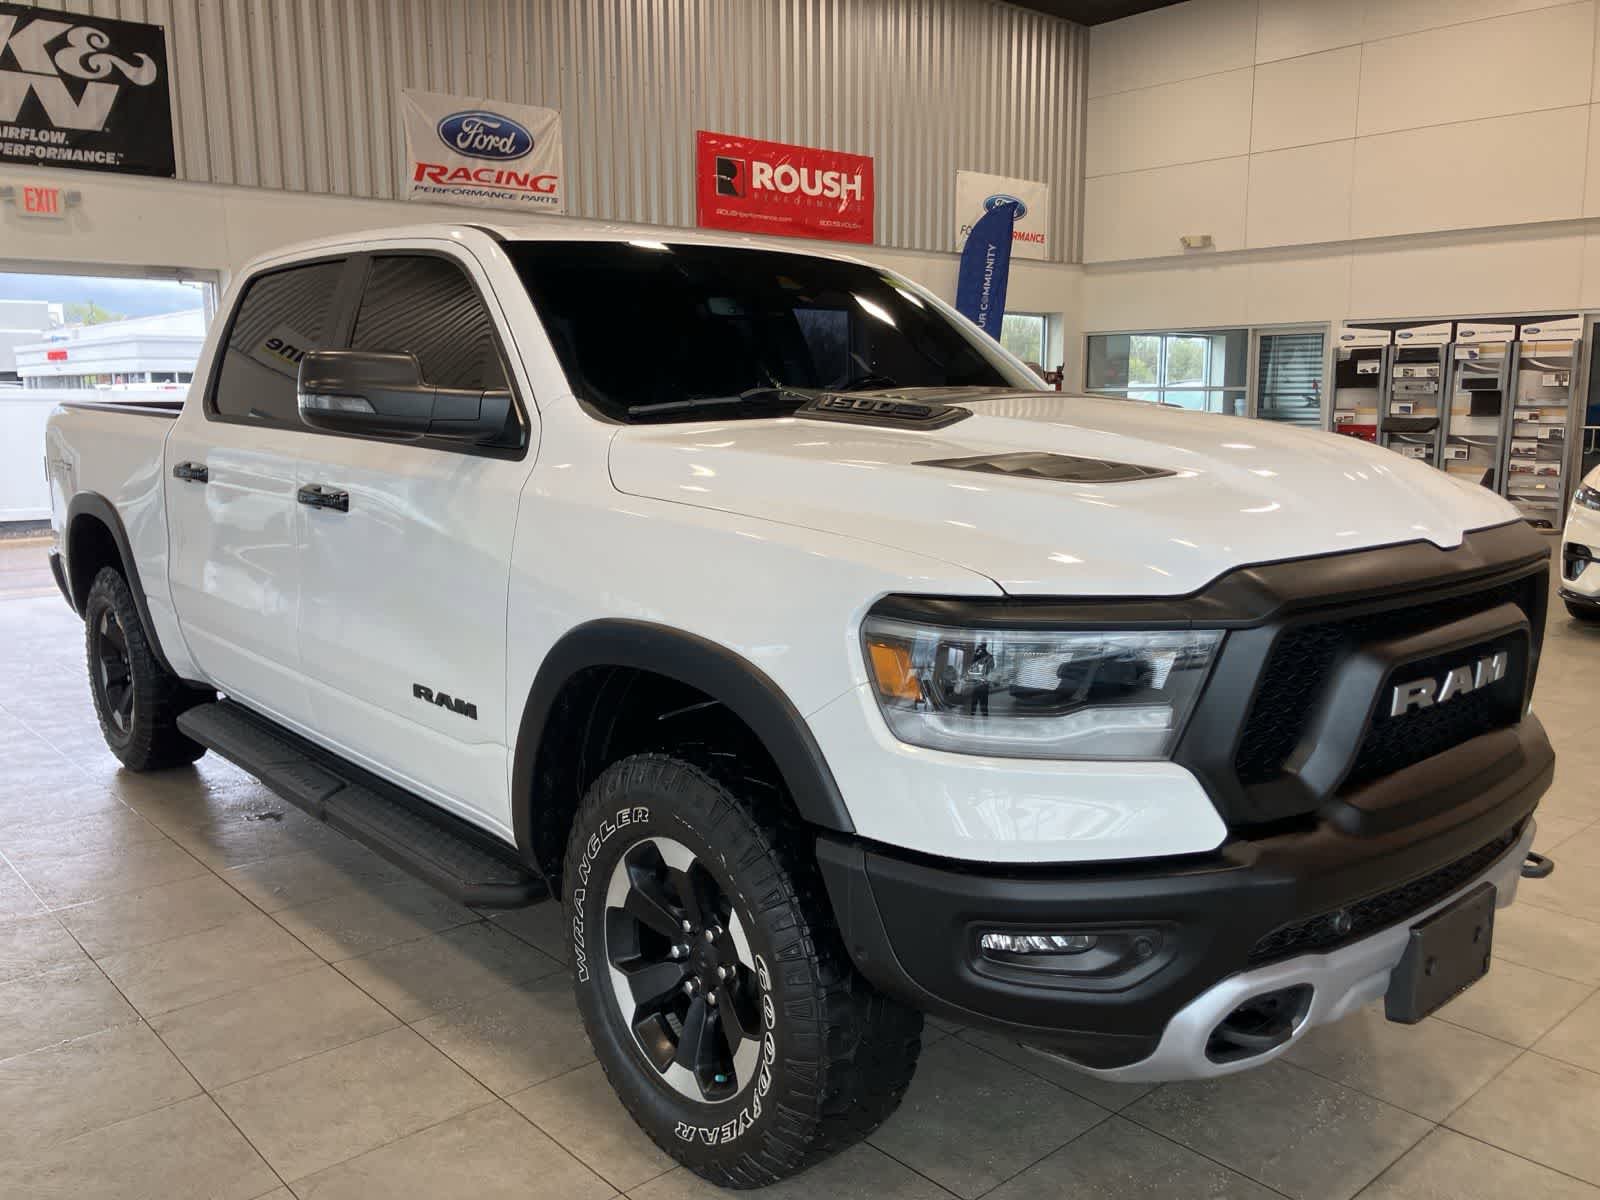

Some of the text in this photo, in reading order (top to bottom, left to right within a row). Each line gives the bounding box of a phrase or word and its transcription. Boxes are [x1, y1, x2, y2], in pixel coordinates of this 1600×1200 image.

[0, 126, 69, 145] IRFLOW.
[456, 116, 516, 154] Ford
[414, 162, 559, 194] RACING
[414, 184, 559, 205] PERFORMANCE PARTS
[752, 160, 862, 201] ROUSH
[23, 187, 59, 214] EXIT
[1011, 231, 1045, 244] RMANCE
[980, 243, 997, 310] COMMUNITY
[822, 395, 898, 413] 1500
[413, 683, 477, 720] RAM
[1391, 651, 1508, 717] RAM
[570, 807, 649, 983] WRANGLER
[674, 954, 776, 1144] GOODYEAR
